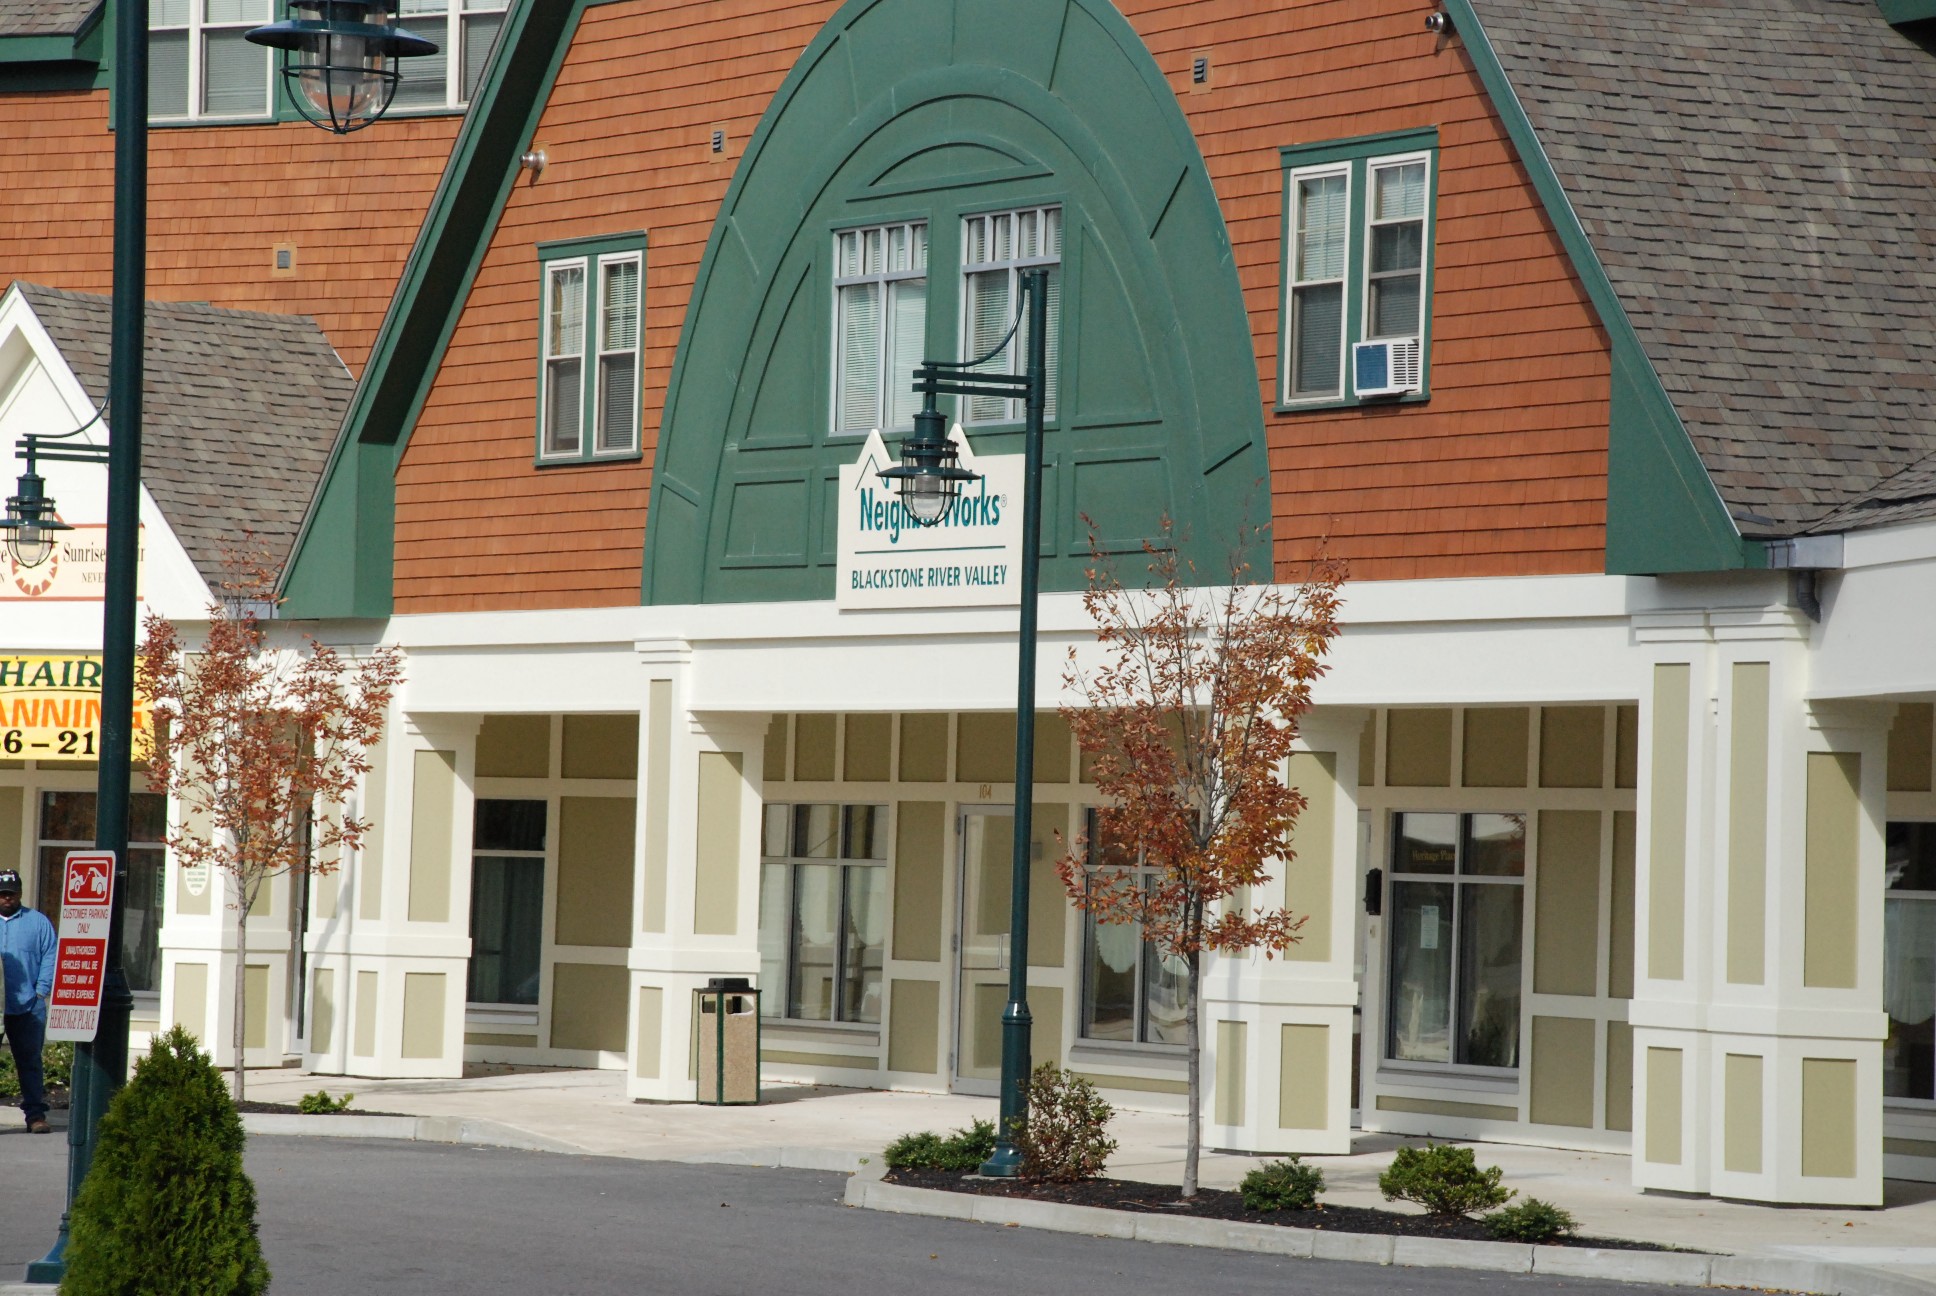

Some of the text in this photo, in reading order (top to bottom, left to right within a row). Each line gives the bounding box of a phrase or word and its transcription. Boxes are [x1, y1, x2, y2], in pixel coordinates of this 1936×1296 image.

[860, 475, 1000, 544] NeighWorks
[63, 541, 106, 563] Sunrise
[82, 572, 105, 583] NEVE
[851, 564, 1007, 590] BLACKSTONE RIVER VALLEY
[0, 660, 102, 687] HAIR
[979, 784, 992, 799] 104
[63, 908, 109, 919] CUSTOMER PARKING
[77, 922, 90, 934] ONLY
[65, 945, 97, 955] UNAUTHORIZED
[61, 960, 99, 970] VEHICLES WILL BE
[62, 974, 95, 984] TOWED AWAY AT
[75, 989, 96, 999] EXPENSE
[49, 1008, 97, 1031] HERITAGE PLACE
